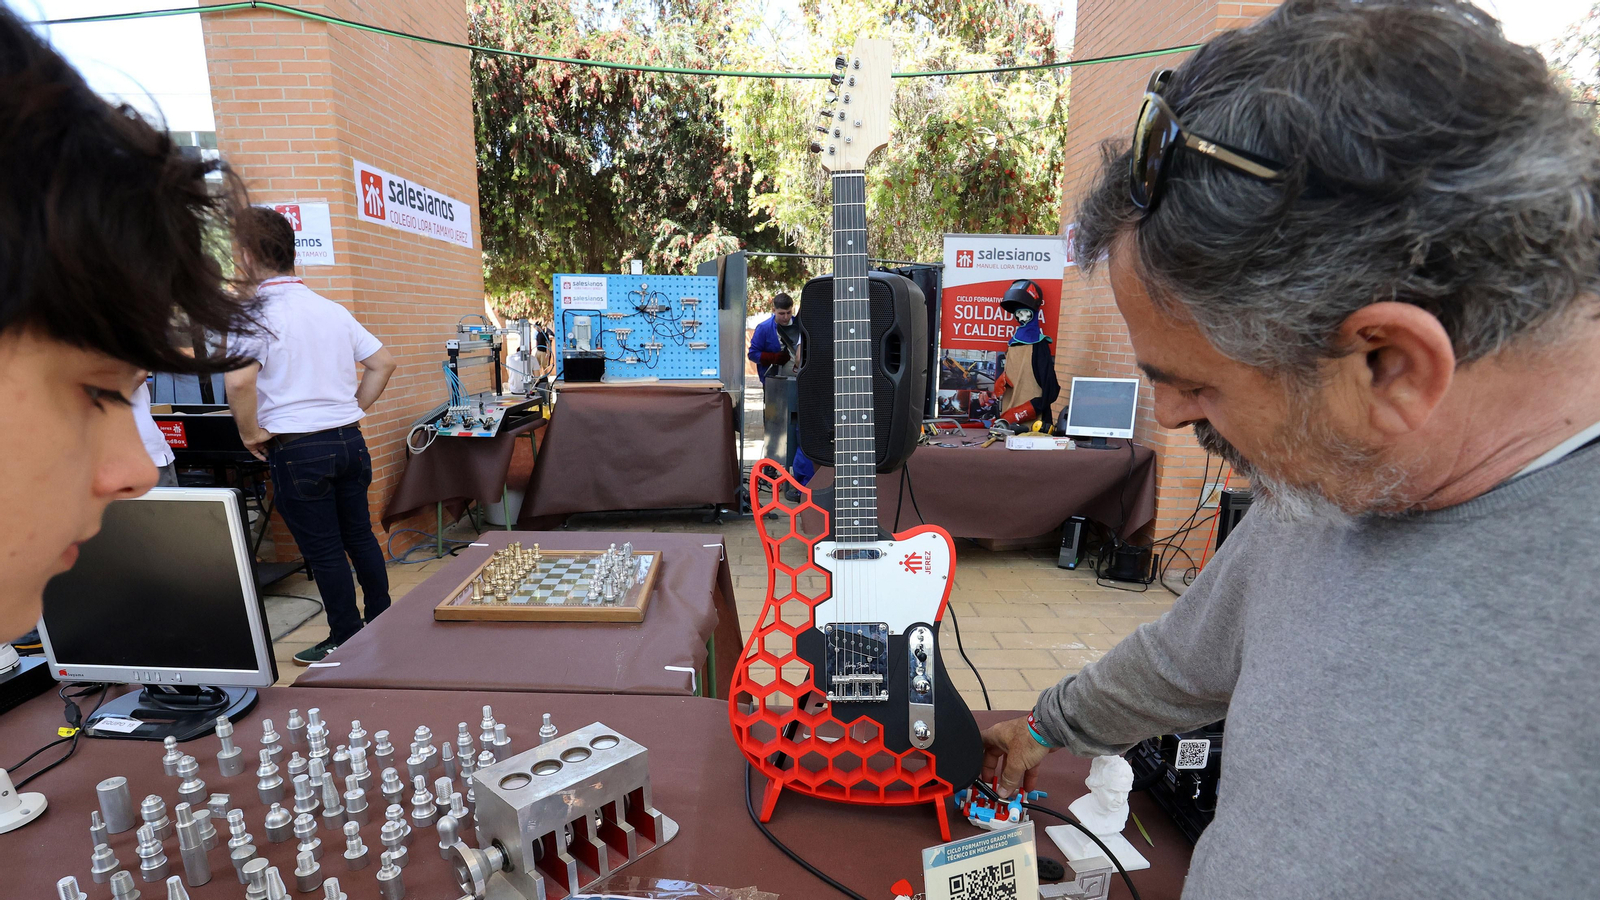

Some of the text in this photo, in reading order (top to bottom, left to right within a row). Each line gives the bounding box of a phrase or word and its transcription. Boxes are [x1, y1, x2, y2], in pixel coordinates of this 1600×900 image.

[388, 179, 454, 222] salesianos
[389, 210, 416, 229] COLEGIO
[433, 222, 454, 239] TAMAYO
[977, 247, 1051, 262] salesianos
[952, 322, 962, 335] Y
[946, 846, 961, 856] CICLO
[961, 838, 990, 851] FORMATIVO
[990, 835, 1007, 844] GRADO
[947, 840, 1009, 862] TÉCNICO EN MECANIZADO
